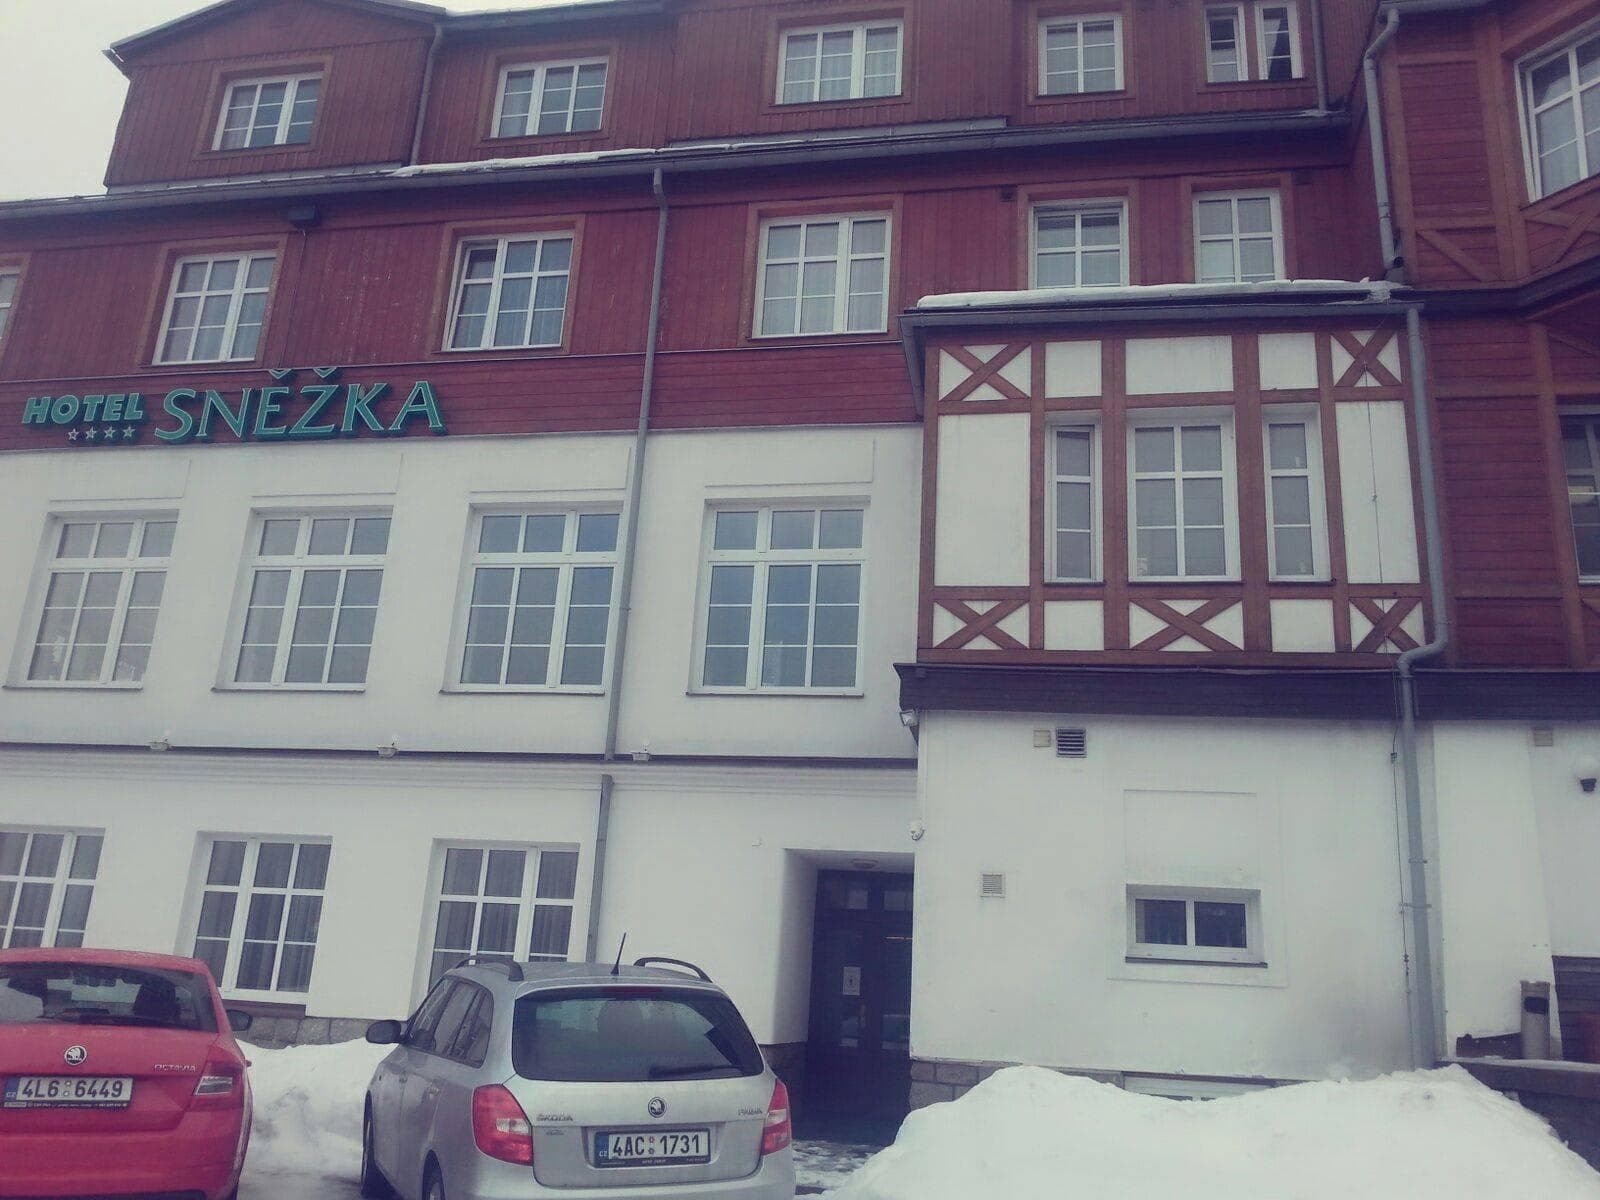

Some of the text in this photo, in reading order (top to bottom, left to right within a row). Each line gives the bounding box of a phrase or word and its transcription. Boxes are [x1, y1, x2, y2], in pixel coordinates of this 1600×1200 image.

[22, 368, 444, 440] HOTEL SNĚŽKA
[22, 1080, 123, 1098] 4L6 6449
[613, 1134, 700, 1156] 4AC 1731
